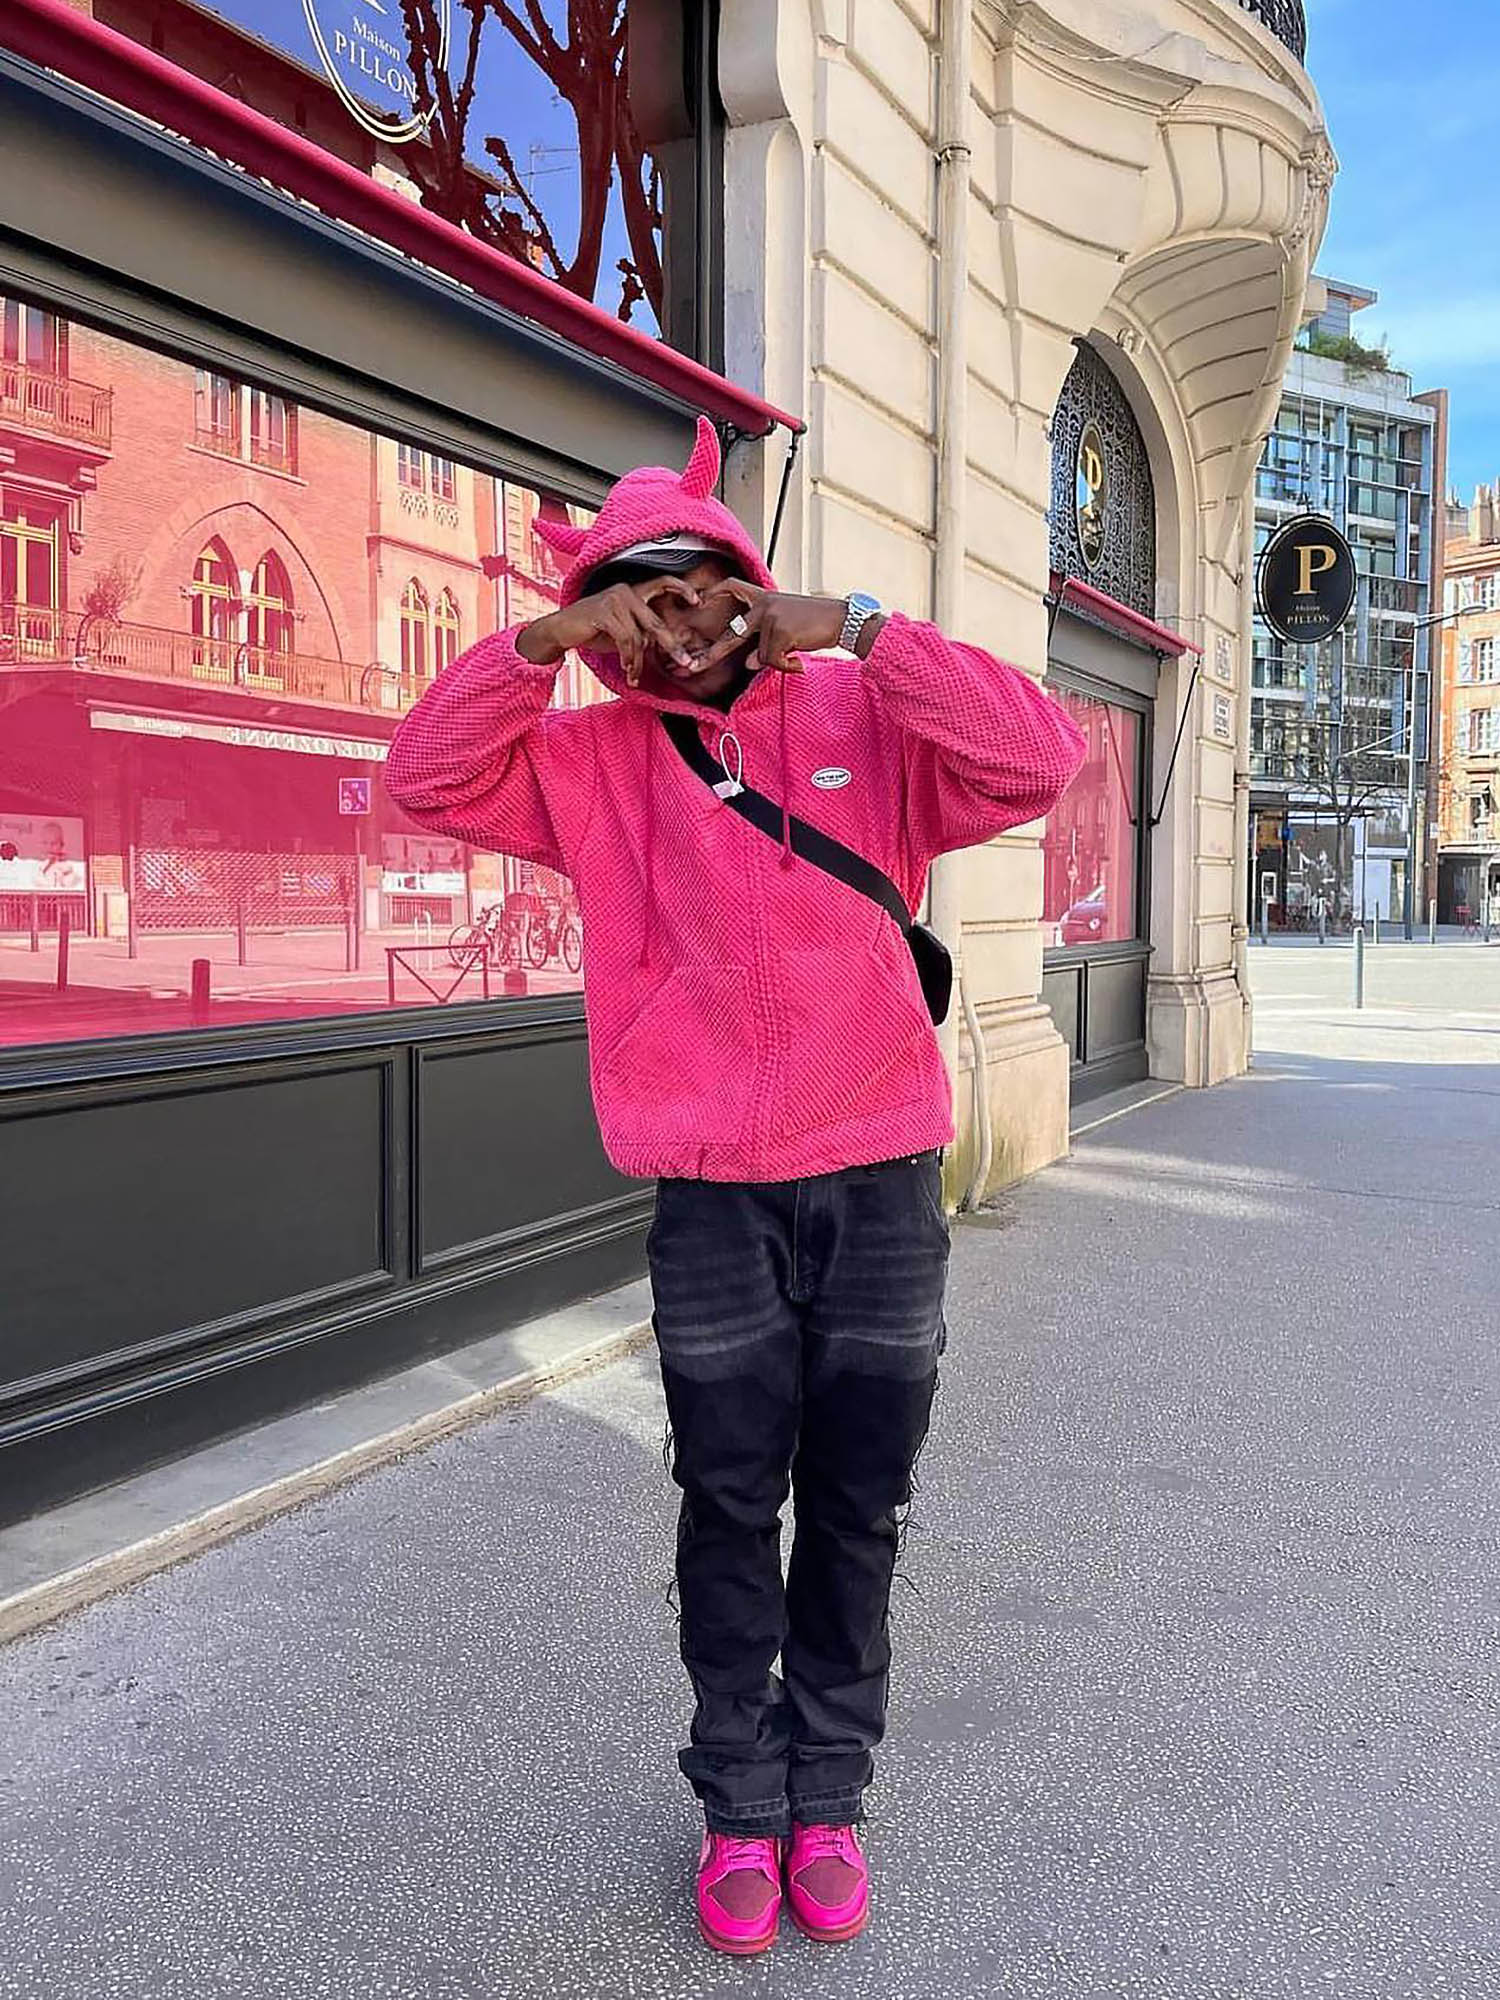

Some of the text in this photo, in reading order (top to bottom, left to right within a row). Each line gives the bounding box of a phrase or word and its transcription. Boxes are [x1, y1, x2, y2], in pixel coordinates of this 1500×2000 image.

[352, 16, 401, 62] Maison
[334, 30, 420, 104] PILLON
[1293, 544, 1337, 594] P
[1286, 613, 1331, 624] PILLON
